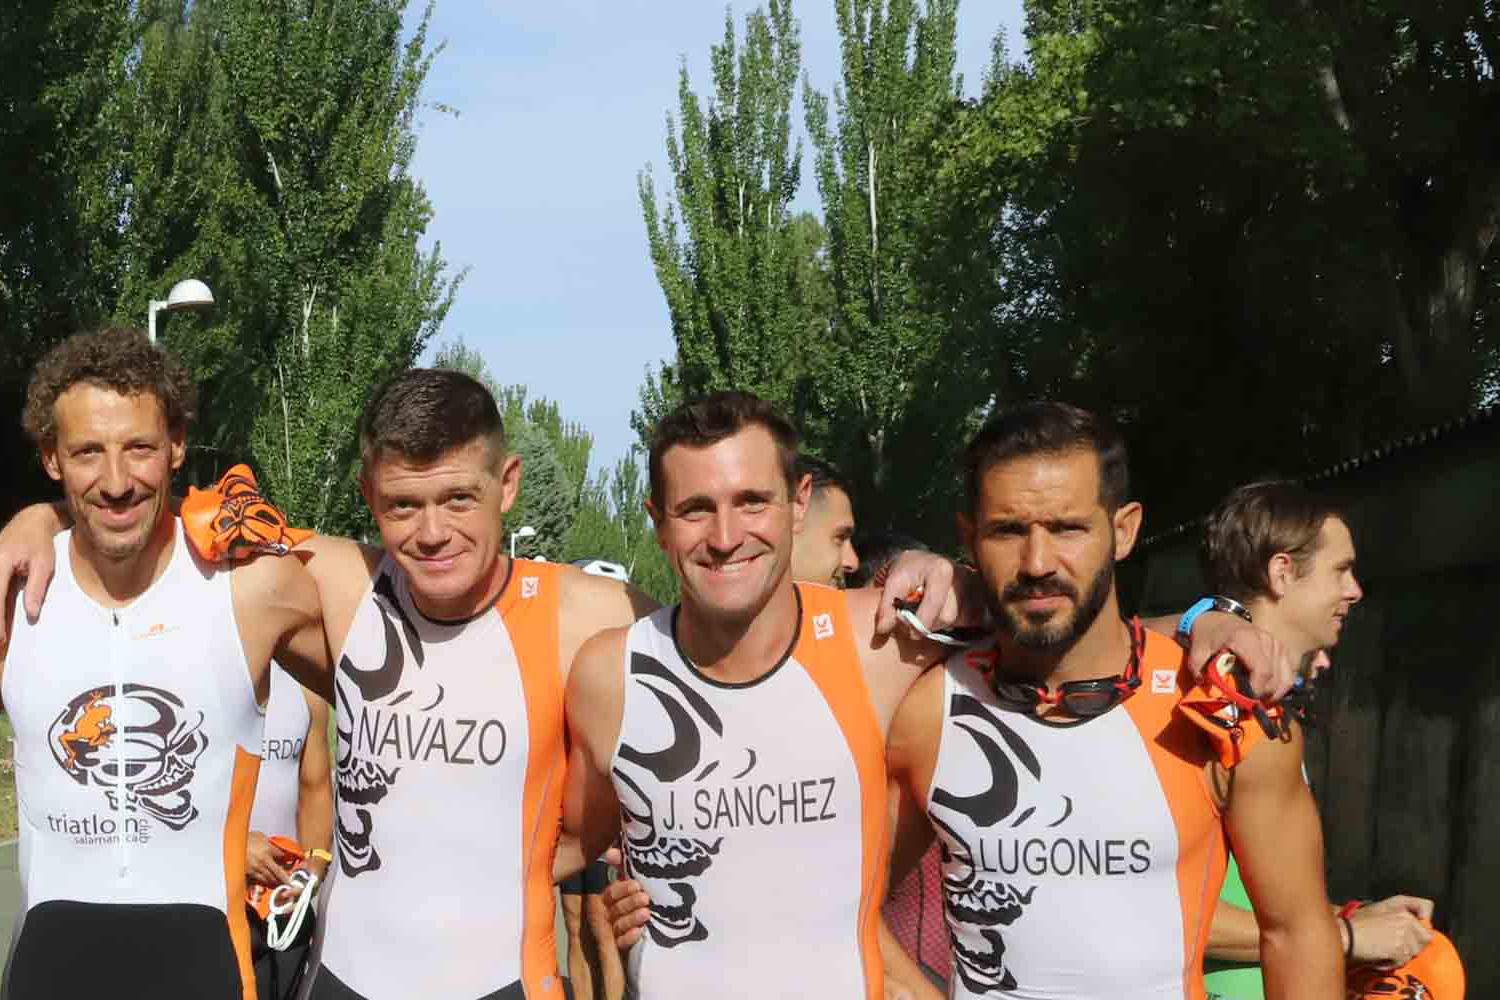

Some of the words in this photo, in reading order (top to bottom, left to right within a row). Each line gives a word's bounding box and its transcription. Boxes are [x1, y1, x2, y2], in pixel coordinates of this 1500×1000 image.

[358, 706, 506, 766] NAVAZO
[663, 790, 684, 831] J.
[694, 777, 837, 830] SANCHEZ
[979, 838, 1150, 876] LUGONES
